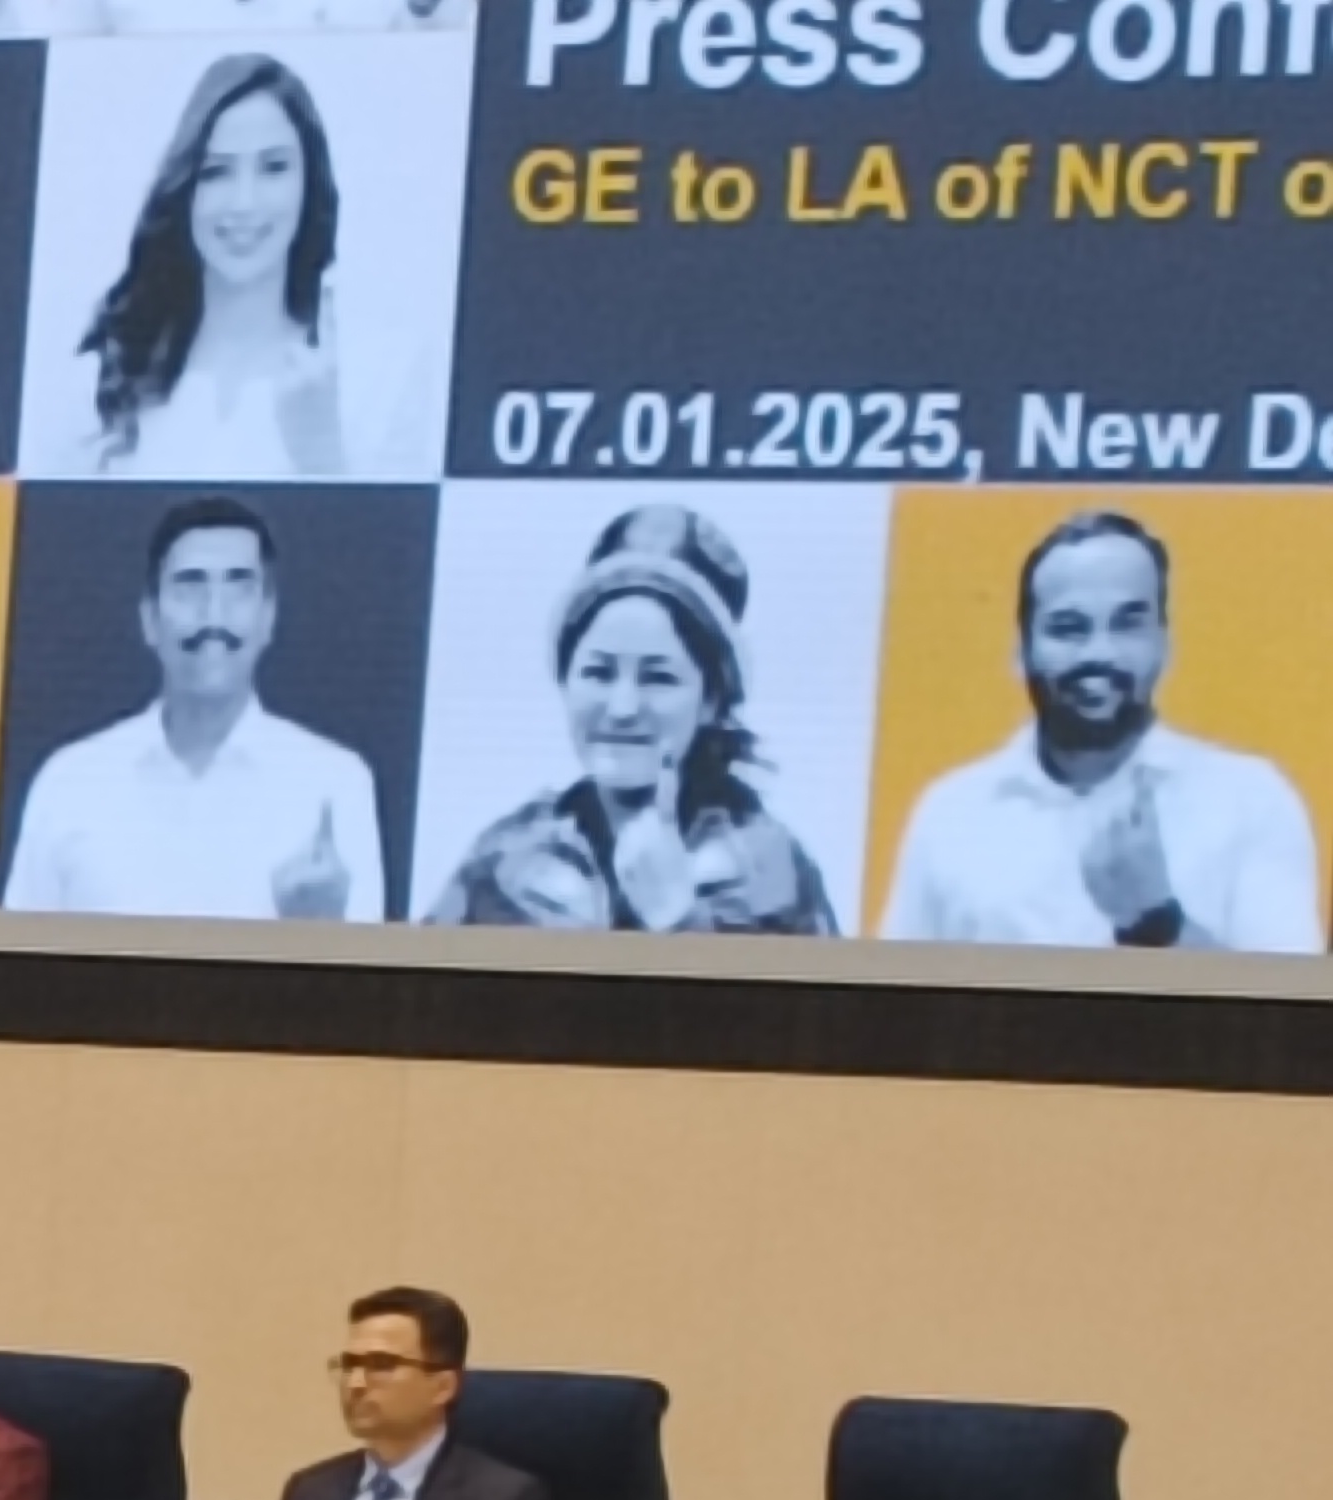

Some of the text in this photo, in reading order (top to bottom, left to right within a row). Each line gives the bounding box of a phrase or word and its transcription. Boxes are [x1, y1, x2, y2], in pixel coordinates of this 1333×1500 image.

[526, 0, 924, 89] Press
[513, 146, 643, 223] GE
[671, 149, 756, 222] to
[788, 145, 907, 222] LA
[936, 142, 1032, 220] of
[1054, 140, 1260, 220] NCT
[493, 391, 1333, 482] 07.01.2025, New D
